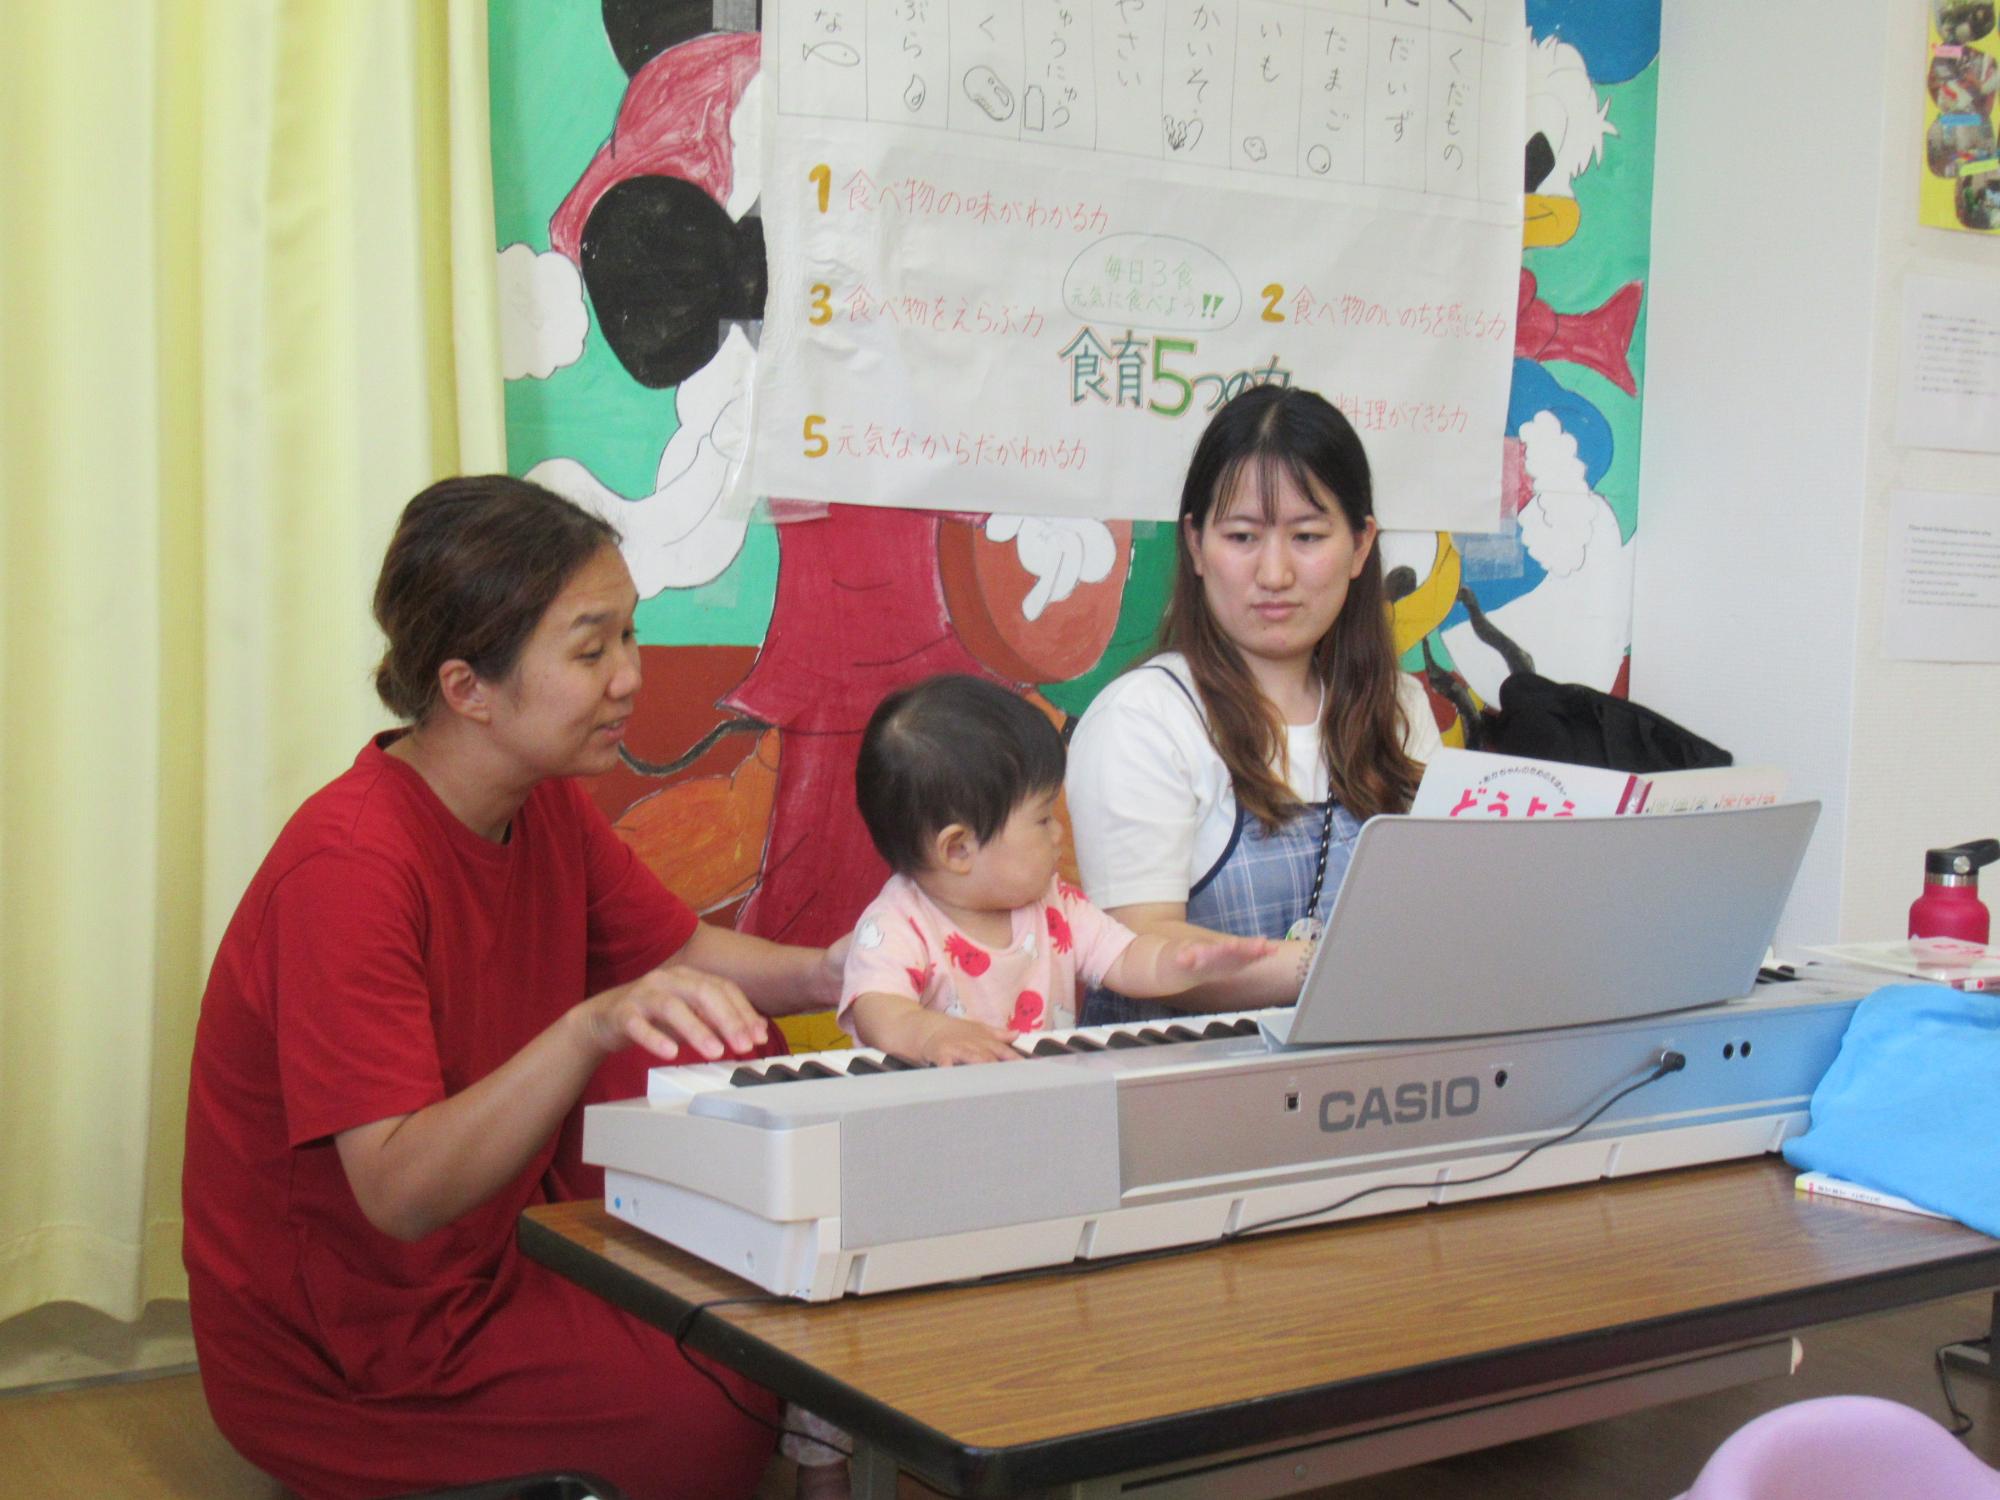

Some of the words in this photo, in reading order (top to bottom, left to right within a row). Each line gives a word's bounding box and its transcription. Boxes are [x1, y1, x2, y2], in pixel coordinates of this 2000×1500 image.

[1046, 0, 1078, 129] ゅうにゅう
[1260, 22, 1283, 84] いも
[1443, 48, 1471, 172] くだもの
[807, 163, 833, 215] 1
[841, 168, 1110, 235] 食べ物の味がわかる力
[807, 282, 833, 327] 3
[846, 283, 1047, 339] 食べ物をえらぶ力
[1260, 283, 1286, 323] 2
[803, 413, 830, 460] 5
[836, 423, 1090, 471] 元気なからだがわかる力
[1319, 1076, 1480, 1133] CASIO
